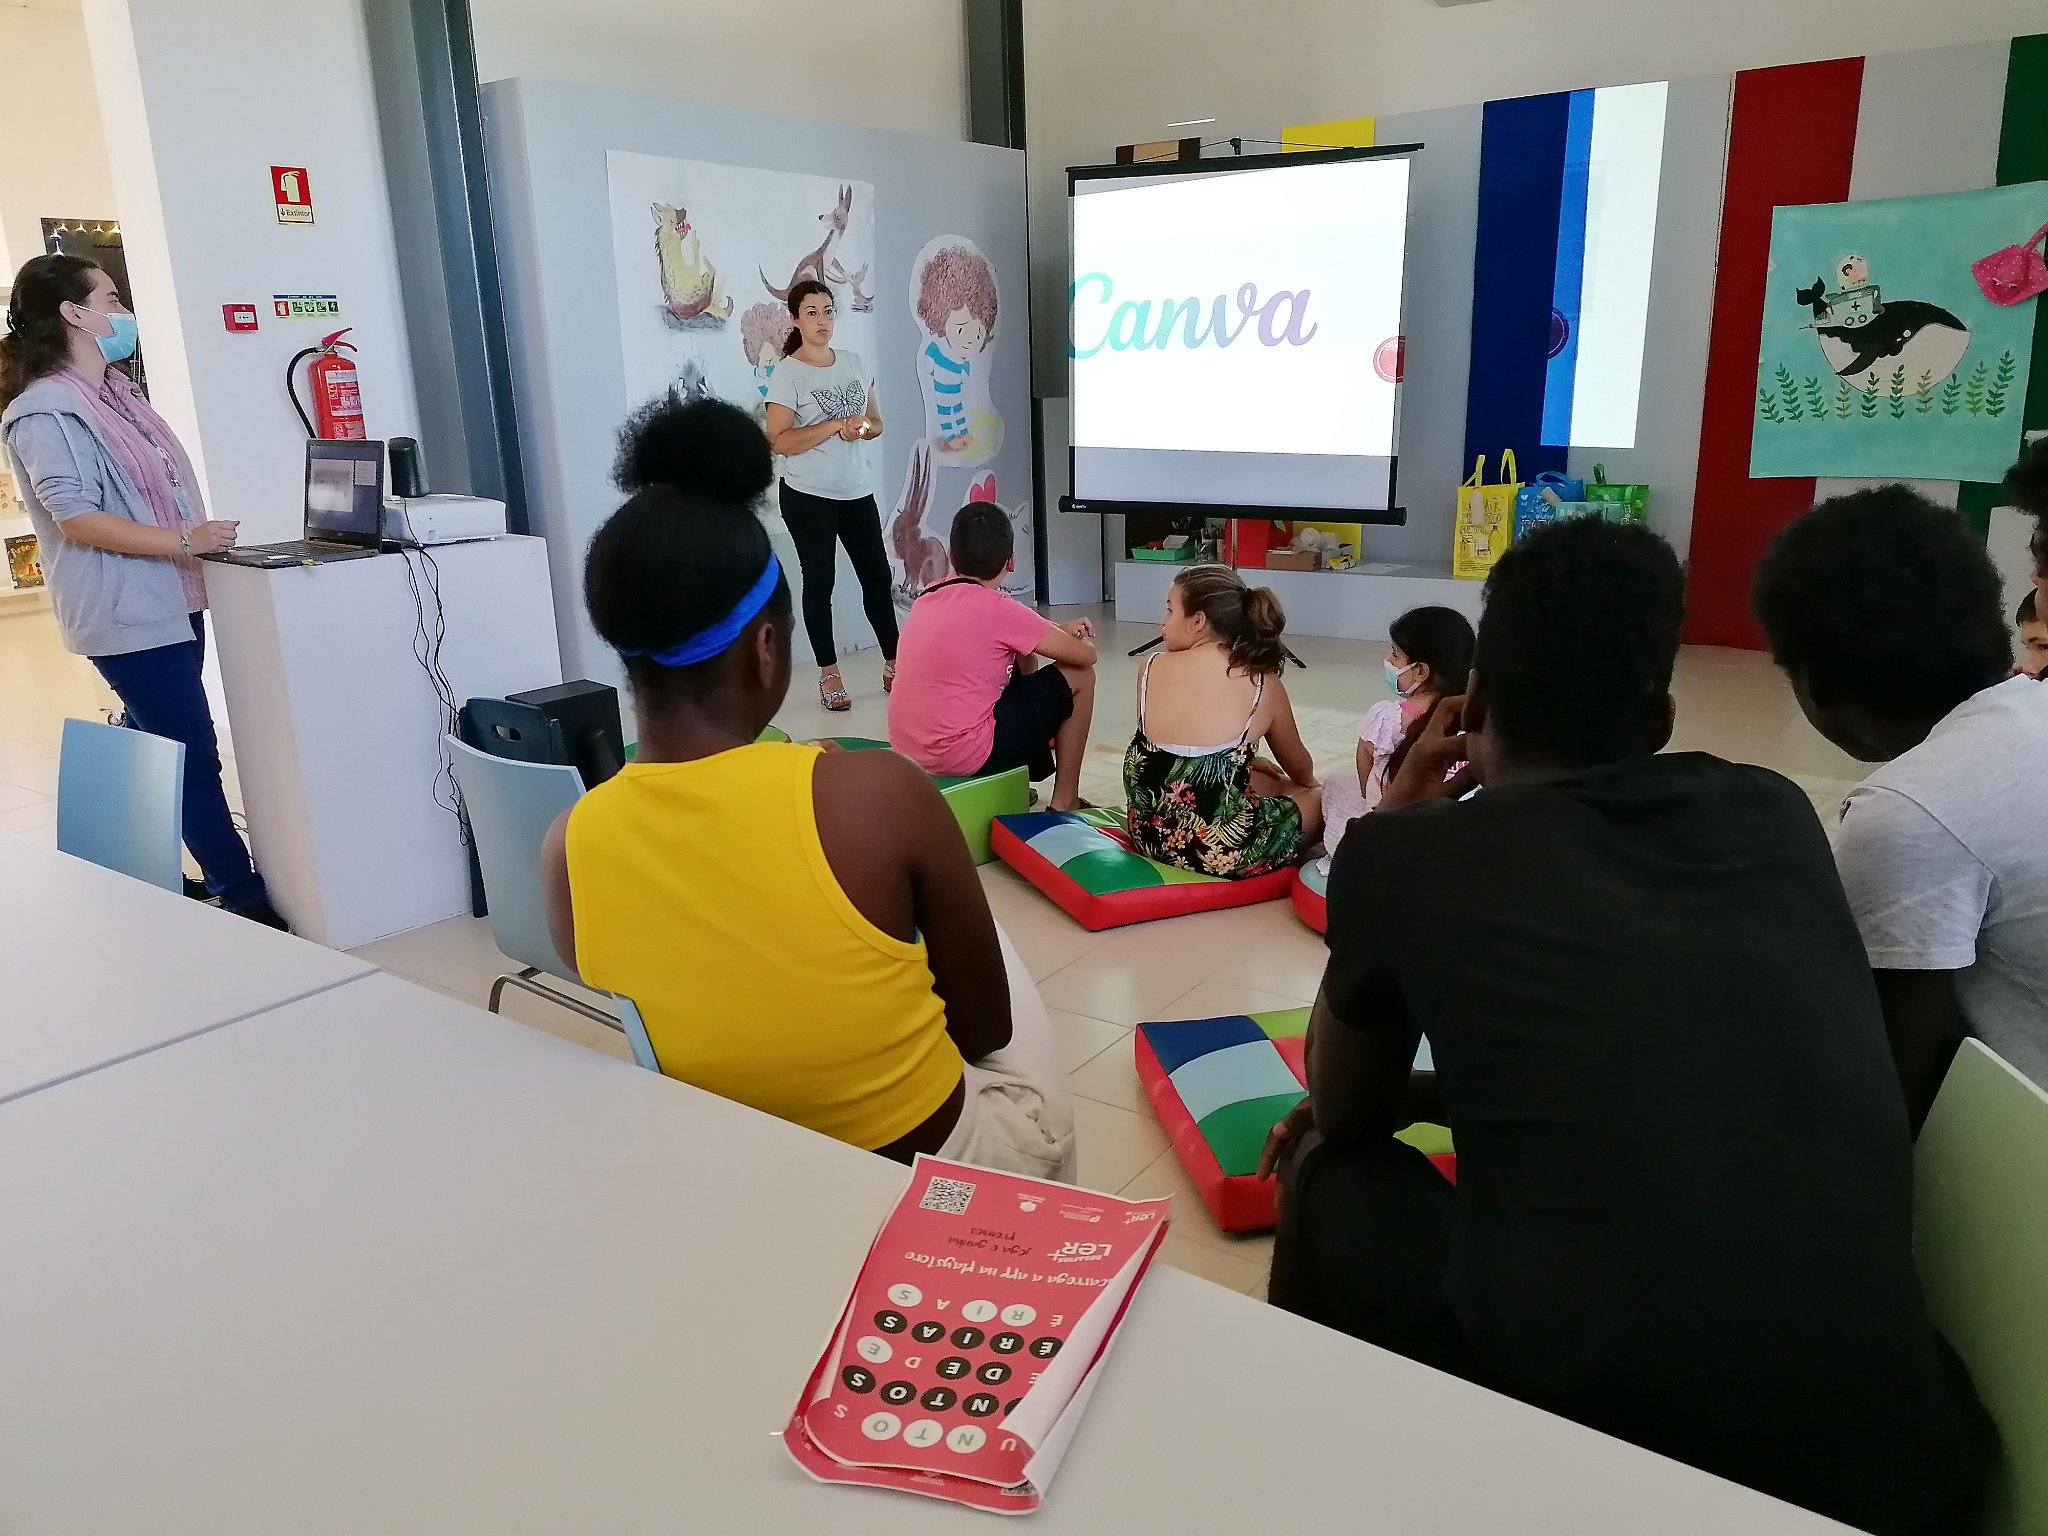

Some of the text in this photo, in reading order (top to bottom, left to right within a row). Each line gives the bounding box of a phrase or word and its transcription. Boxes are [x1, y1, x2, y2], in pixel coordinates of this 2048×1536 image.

[286, 209, 311, 217] Extintor
[1068, 271, 1318, 360] Canva
[904, 1250, 976, 1275] playstore
[979, 1266, 998, 1277] na
[1000, 1266, 1029, 1282] app
[1032, 1273, 1044, 1281] a
